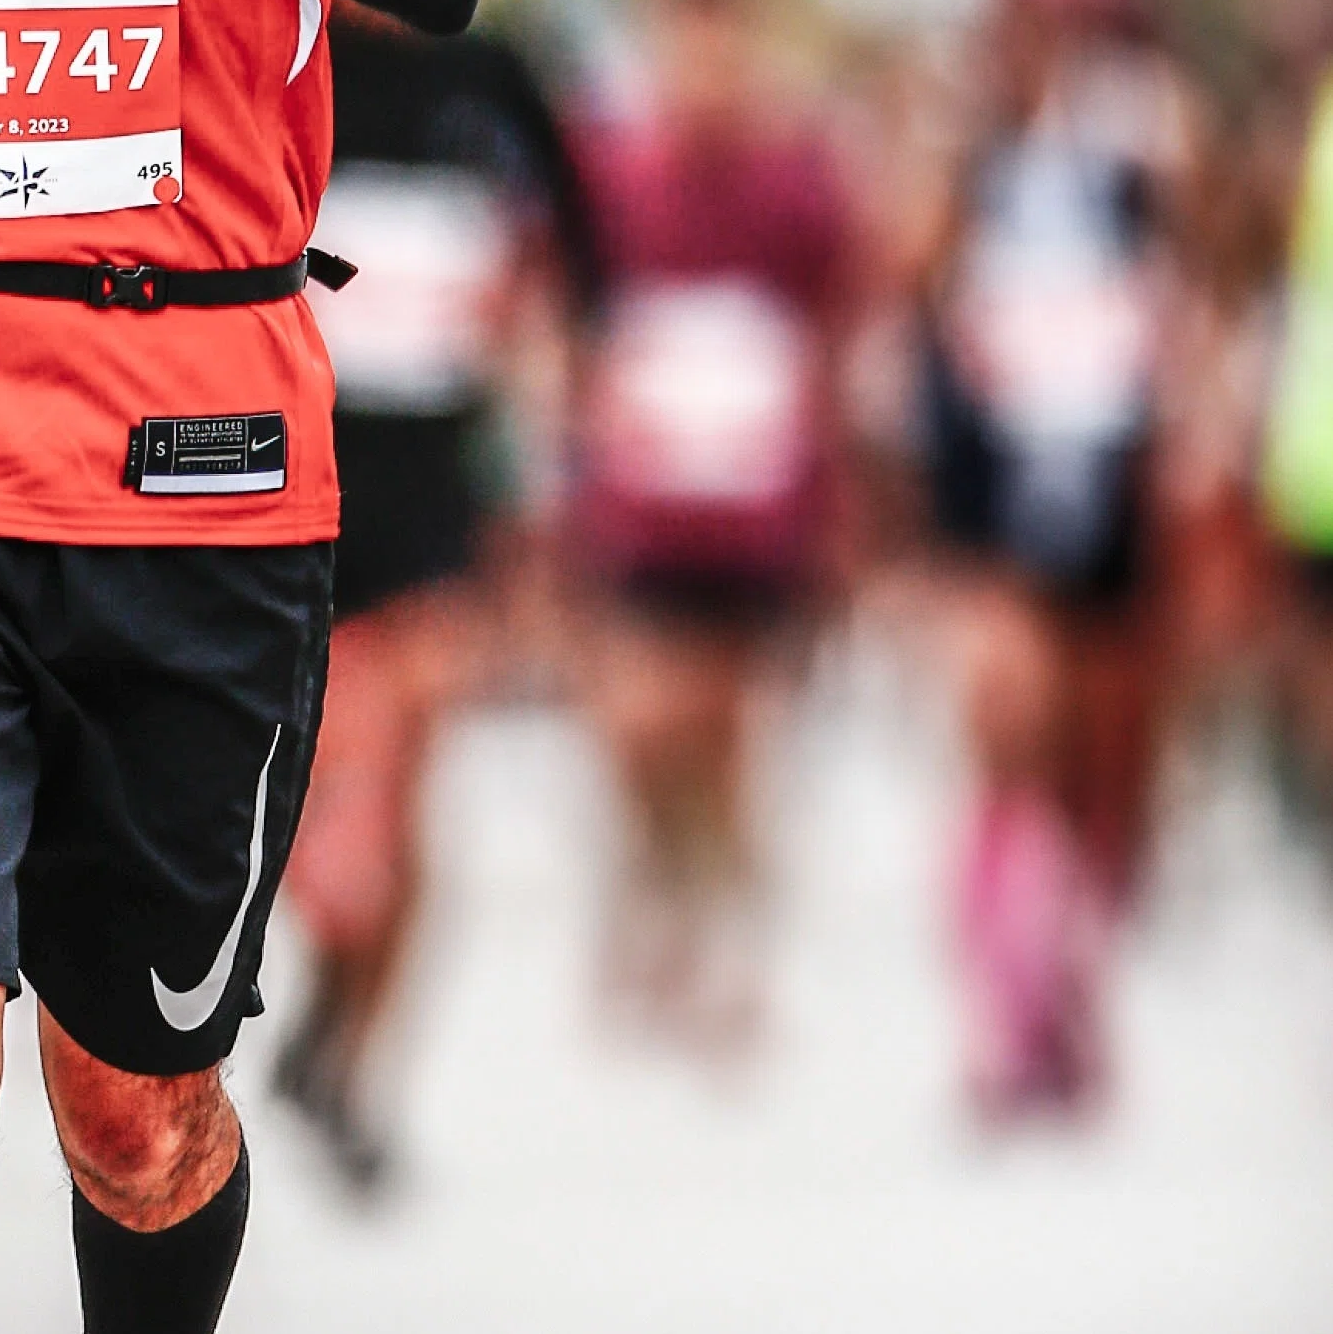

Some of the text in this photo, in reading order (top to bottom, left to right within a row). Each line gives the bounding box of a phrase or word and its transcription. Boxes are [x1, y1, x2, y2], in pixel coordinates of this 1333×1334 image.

[8, 120, 24, 136] 8,
[28, 117, 69, 134] 2023
[137, 161, 174, 181] 495
[179, 421, 243, 433] ENGINEERED
[155, 441, 166, 457] S
